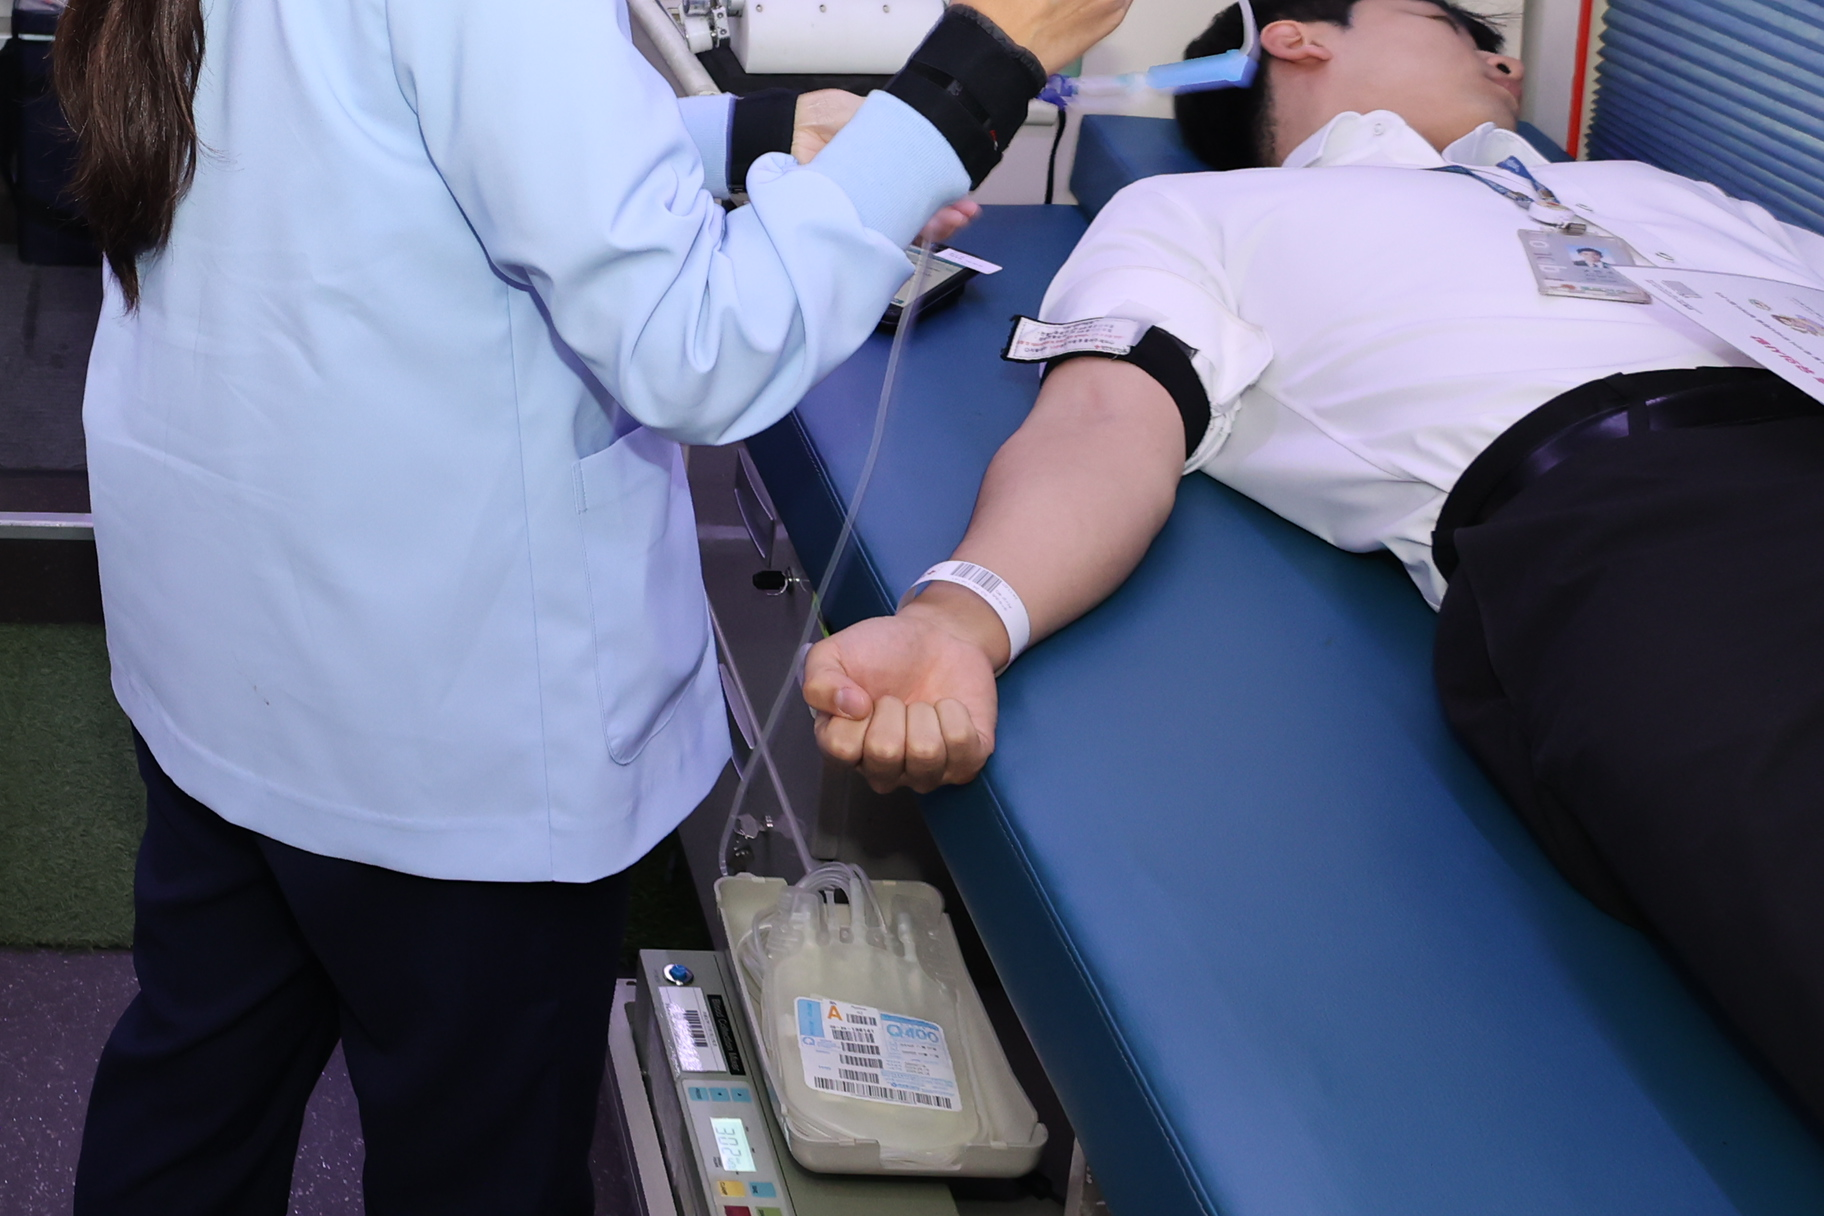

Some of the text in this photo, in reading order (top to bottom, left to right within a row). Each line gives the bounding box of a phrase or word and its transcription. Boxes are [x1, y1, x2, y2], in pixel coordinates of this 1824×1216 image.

[827, 1005, 843, 1021] A
[711, 998, 741, 1072] Blood Collection Mixer
[886, 1023, 940, 1044] Q400
[716, 1127, 742, 1157] 302
